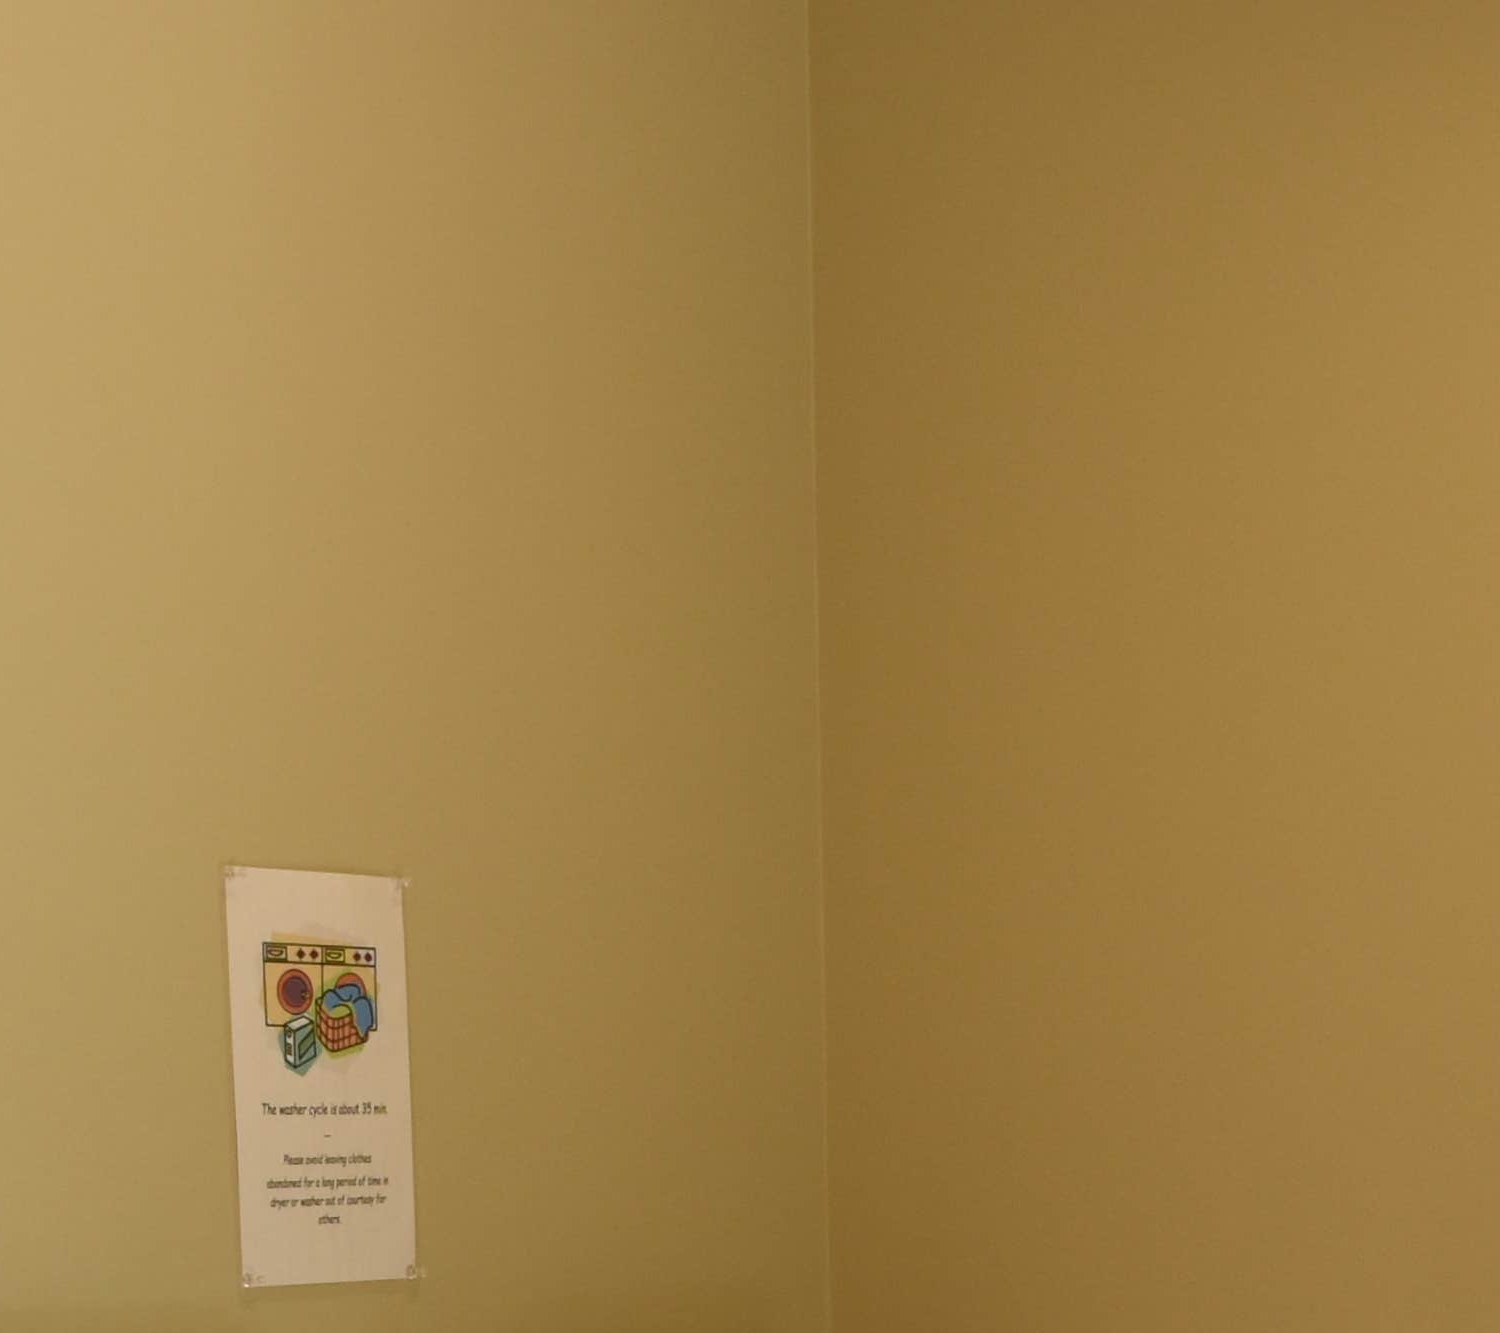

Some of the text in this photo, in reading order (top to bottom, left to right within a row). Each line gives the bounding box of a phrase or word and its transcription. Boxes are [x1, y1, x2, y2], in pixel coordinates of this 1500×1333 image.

[262, 1102, 277, 1116] The
[279, 1104, 307, 1116] washer
[308, 1103, 328, 1118] cycle
[338, 1104, 360, 1116] about
[283, 1154, 304, 1166] Please
[348, 1153, 372, 1165] clothes
[304, 1177, 315, 1188] for
[321, 1177, 334, 1190] long
[336, 1176, 357, 1189] period
[358, 1175, 366, 1186] of
[270, 1196, 290, 1210] dryer
[300, 1196, 324, 1207] washer
[337, 1195, 345, 1205] of
